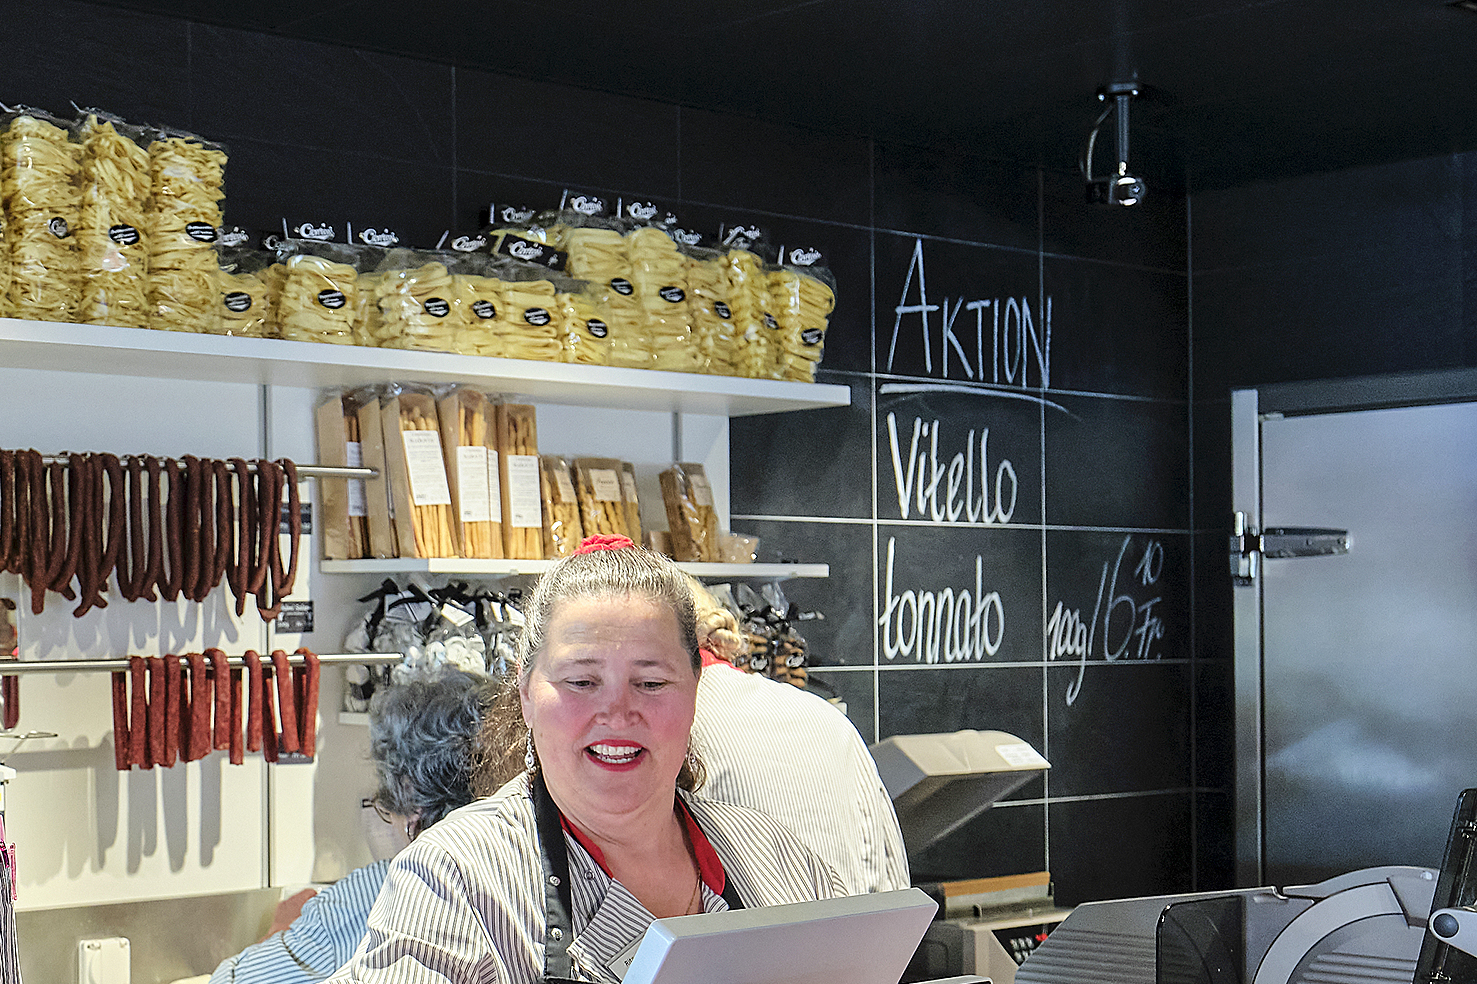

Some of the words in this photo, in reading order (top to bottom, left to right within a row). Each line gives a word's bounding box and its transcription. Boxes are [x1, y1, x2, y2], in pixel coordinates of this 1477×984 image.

[886, 237, 1052, 390] AKTION
[886, 411, 1018, 524] Vitello
[878, 536, 1005, 664] tonnato
